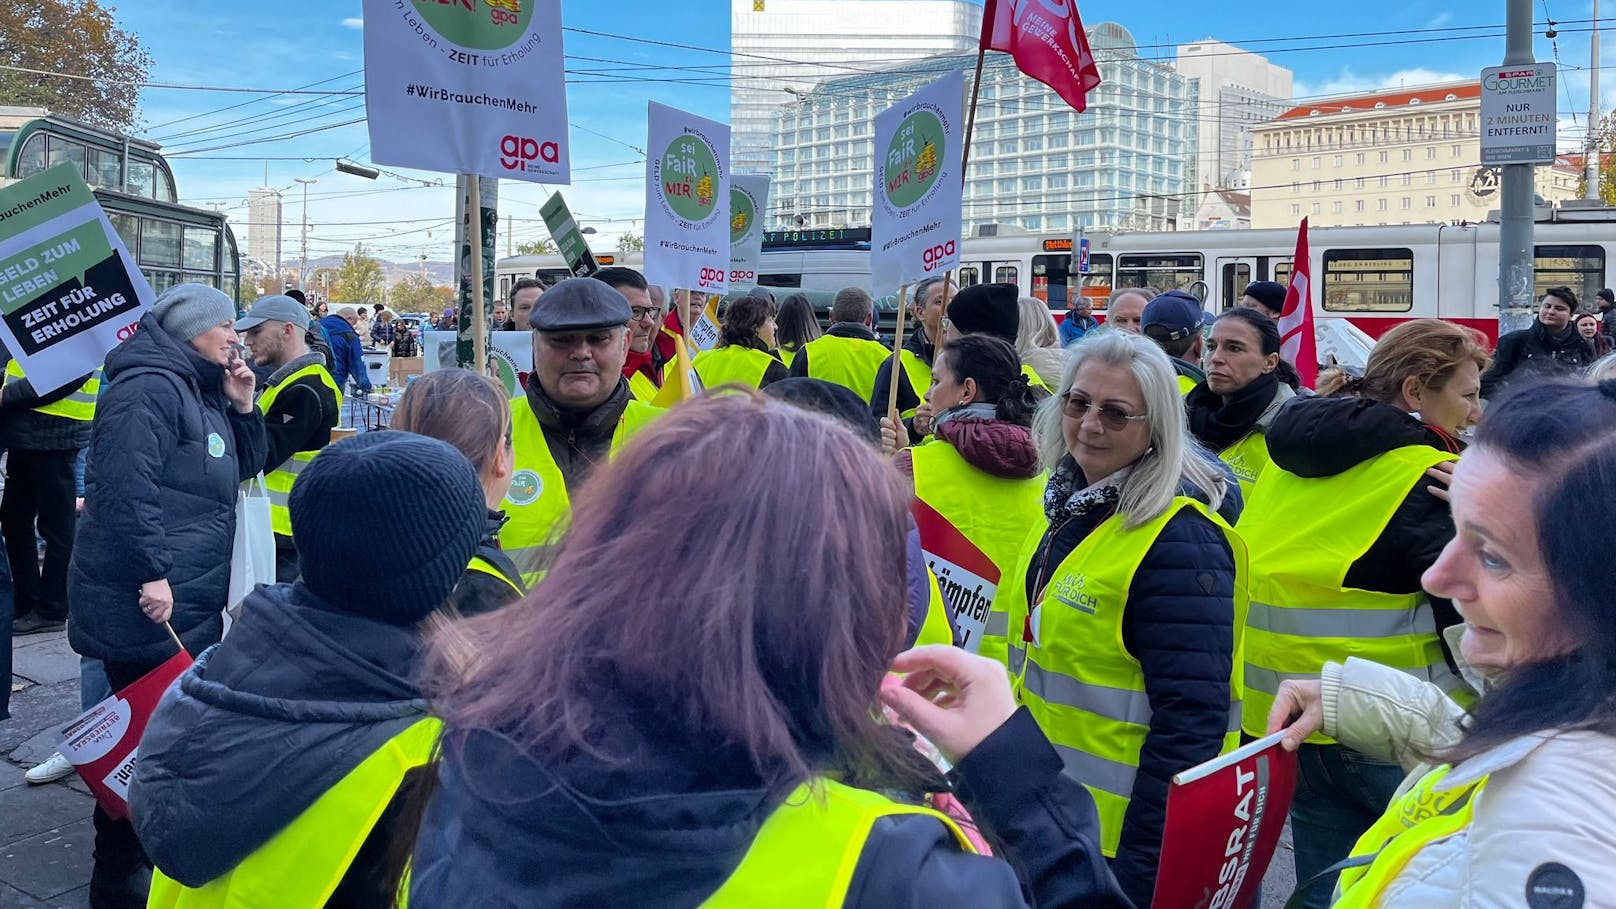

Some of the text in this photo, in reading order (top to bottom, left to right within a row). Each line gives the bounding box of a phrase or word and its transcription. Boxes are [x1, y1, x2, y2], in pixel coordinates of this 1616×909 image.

[490, 8, 518, 27] gpa
[1026, 12, 1057, 37] MEINE
[403, 11, 438, 48] Leben
[449, 48, 479, 66] ZEIT
[483, 55, 499, 67] für
[501, 32, 542, 66] Erholung
[1483, 73, 1555, 92] GOURMET
[406, 83, 537, 115] #WirBrauchenMehr
[1506, 103, 1530, 112] NUR
[901, 120, 914, 140] sei
[1487, 114, 1550, 125] 2 MINUTEN
[1488, 126, 1548, 137] ENTFERNT!
[499, 134, 560, 171] gpa
[681, 142, 696, 155] sei
[888, 138, 916, 169] FaiR
[666, 153, 697, 178] FaiR
[784, 230, 843, 241] POLIZEI
[882, 221, 942, 252] #WirBrauchenMehr
[41, 238, 80, 264] ZUM
[660, 240, 718, 256] #WirBrauchenMehr
[922, 240, 955, 271] gpa
[2, 269, 59, 303] LEBEN
[699, 267, 725, 287] gpa
[730, 270, 754, 283] gpa
[21, 285, 97, 328] ZEIT FÜR
[31, 292, 127, 344] ERHOLUNG
[1235, 466, 1258, 479] DICH
[1070, 589, 1097, 608] DICH
[73, 714, 120, 751] BETRIEBSRAT
